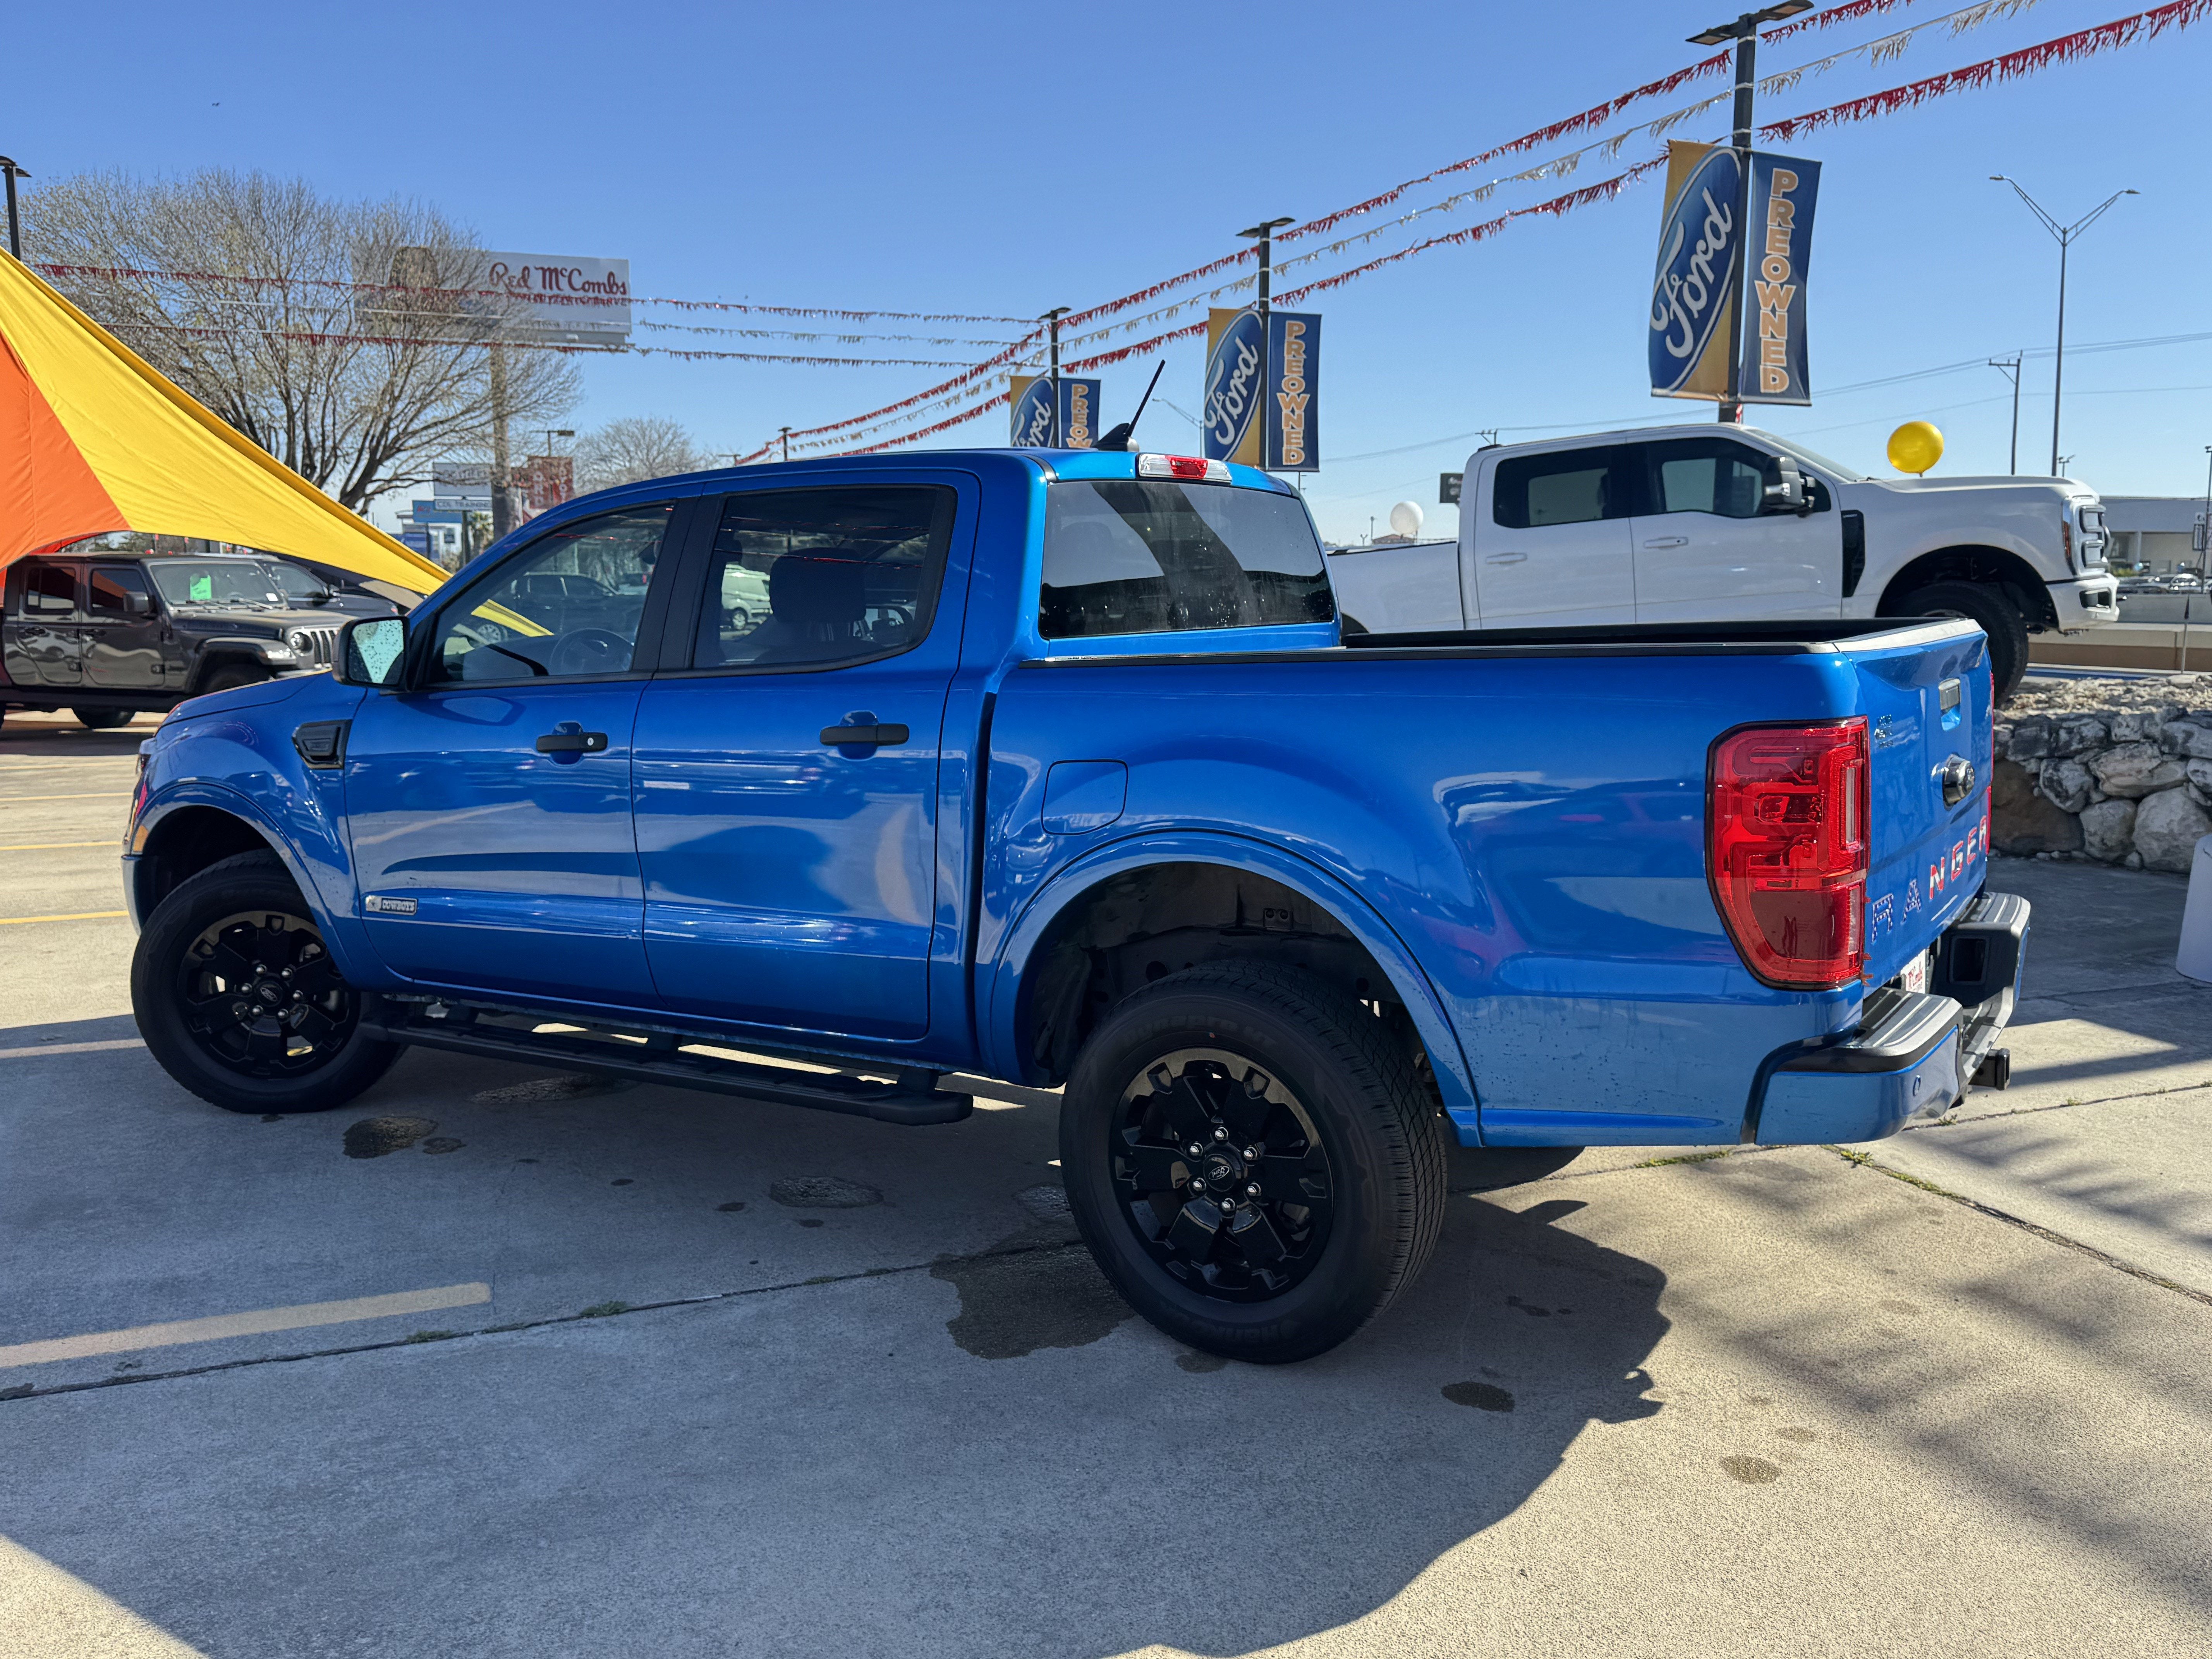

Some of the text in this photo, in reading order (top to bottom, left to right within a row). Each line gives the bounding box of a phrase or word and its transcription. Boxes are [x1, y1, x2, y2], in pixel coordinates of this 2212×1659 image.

[489, 262, 627, 295] Red McCombs
[1650, 187, 1733, 358] Ford
[1754, 168, 1798, 393] PREOWNED
[1011, 396, 1051, 447] Frd
[1204, 337, 1259, 445] Ford
[1277, 320, 1310, 465] PREOWNED
[1871, 815, 1987, 945] RANGER
